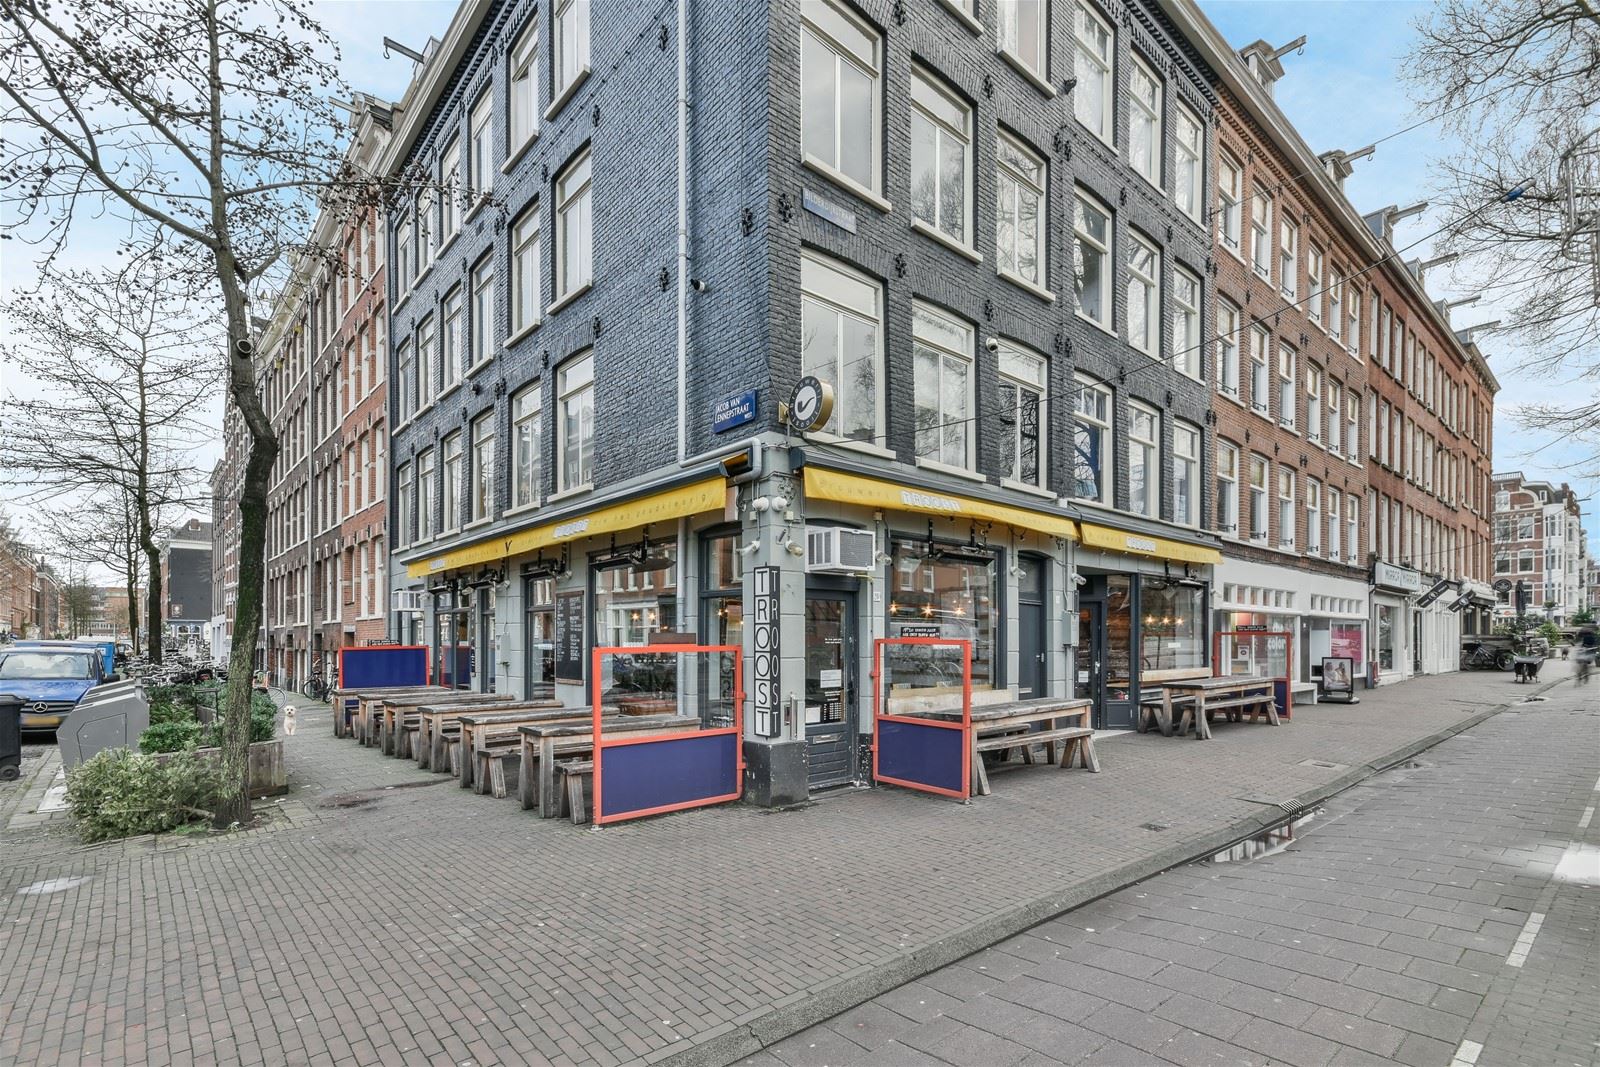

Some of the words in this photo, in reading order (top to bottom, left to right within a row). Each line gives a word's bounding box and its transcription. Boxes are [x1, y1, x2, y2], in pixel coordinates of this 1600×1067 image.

[715, 401, 729, 412] JACOB
[730, 397, 740, 408] VAN
[715, 403, 750, 423] LENNEPSTRAAT
[756, 569, 770, 733] TROOST
[771, 569, 779, 733] TROOST
[1267, 636, 1287, 650] color
